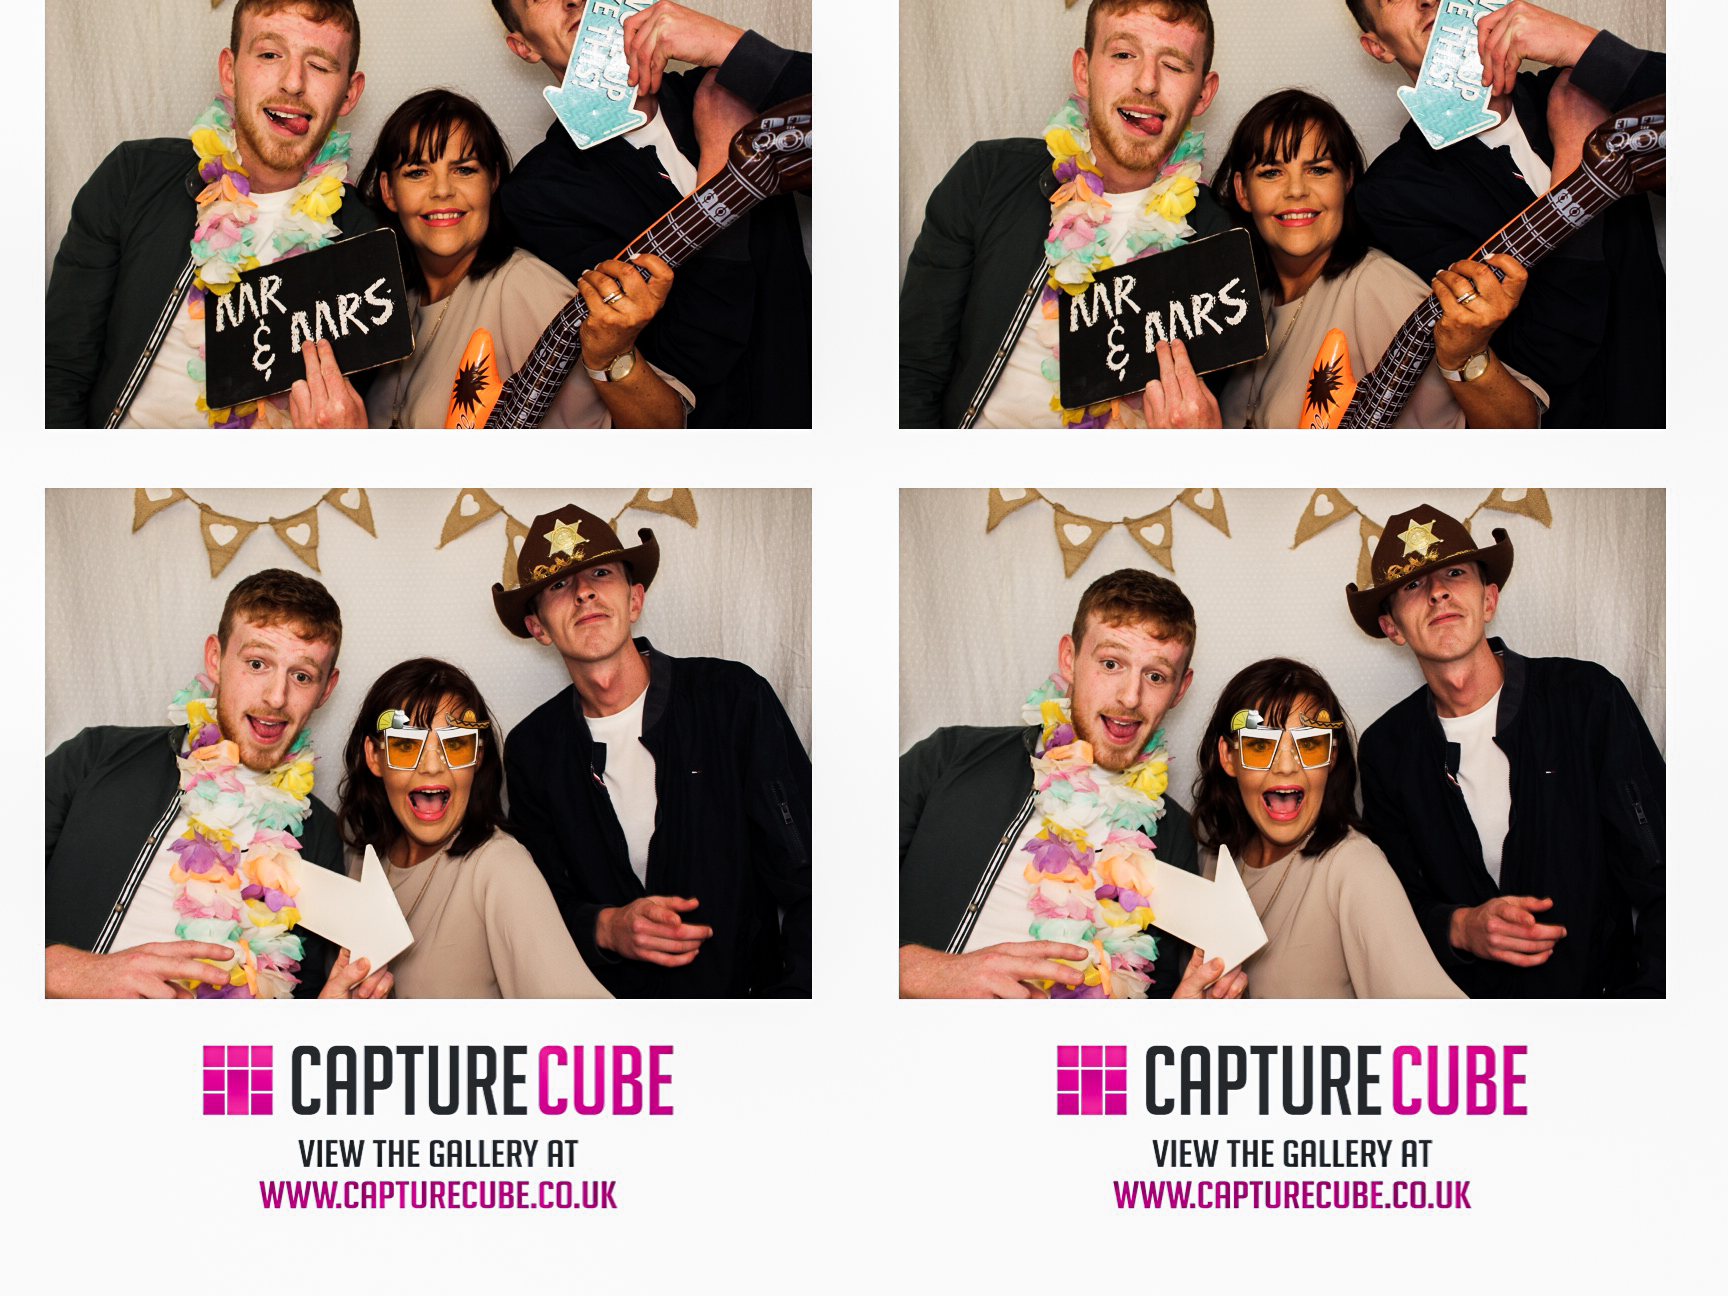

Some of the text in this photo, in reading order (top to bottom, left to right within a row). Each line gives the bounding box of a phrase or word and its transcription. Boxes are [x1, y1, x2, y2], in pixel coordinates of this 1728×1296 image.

[570, 25, 615, 91] THIS!
[1424, 25, 1469, 91] THIS!
[215, 274, 288, 333] MR
[290, 277, 396, 354] MRS
[1069, 274, 1142, 333] MR
[1144, 277, 1250, 354] MRS
